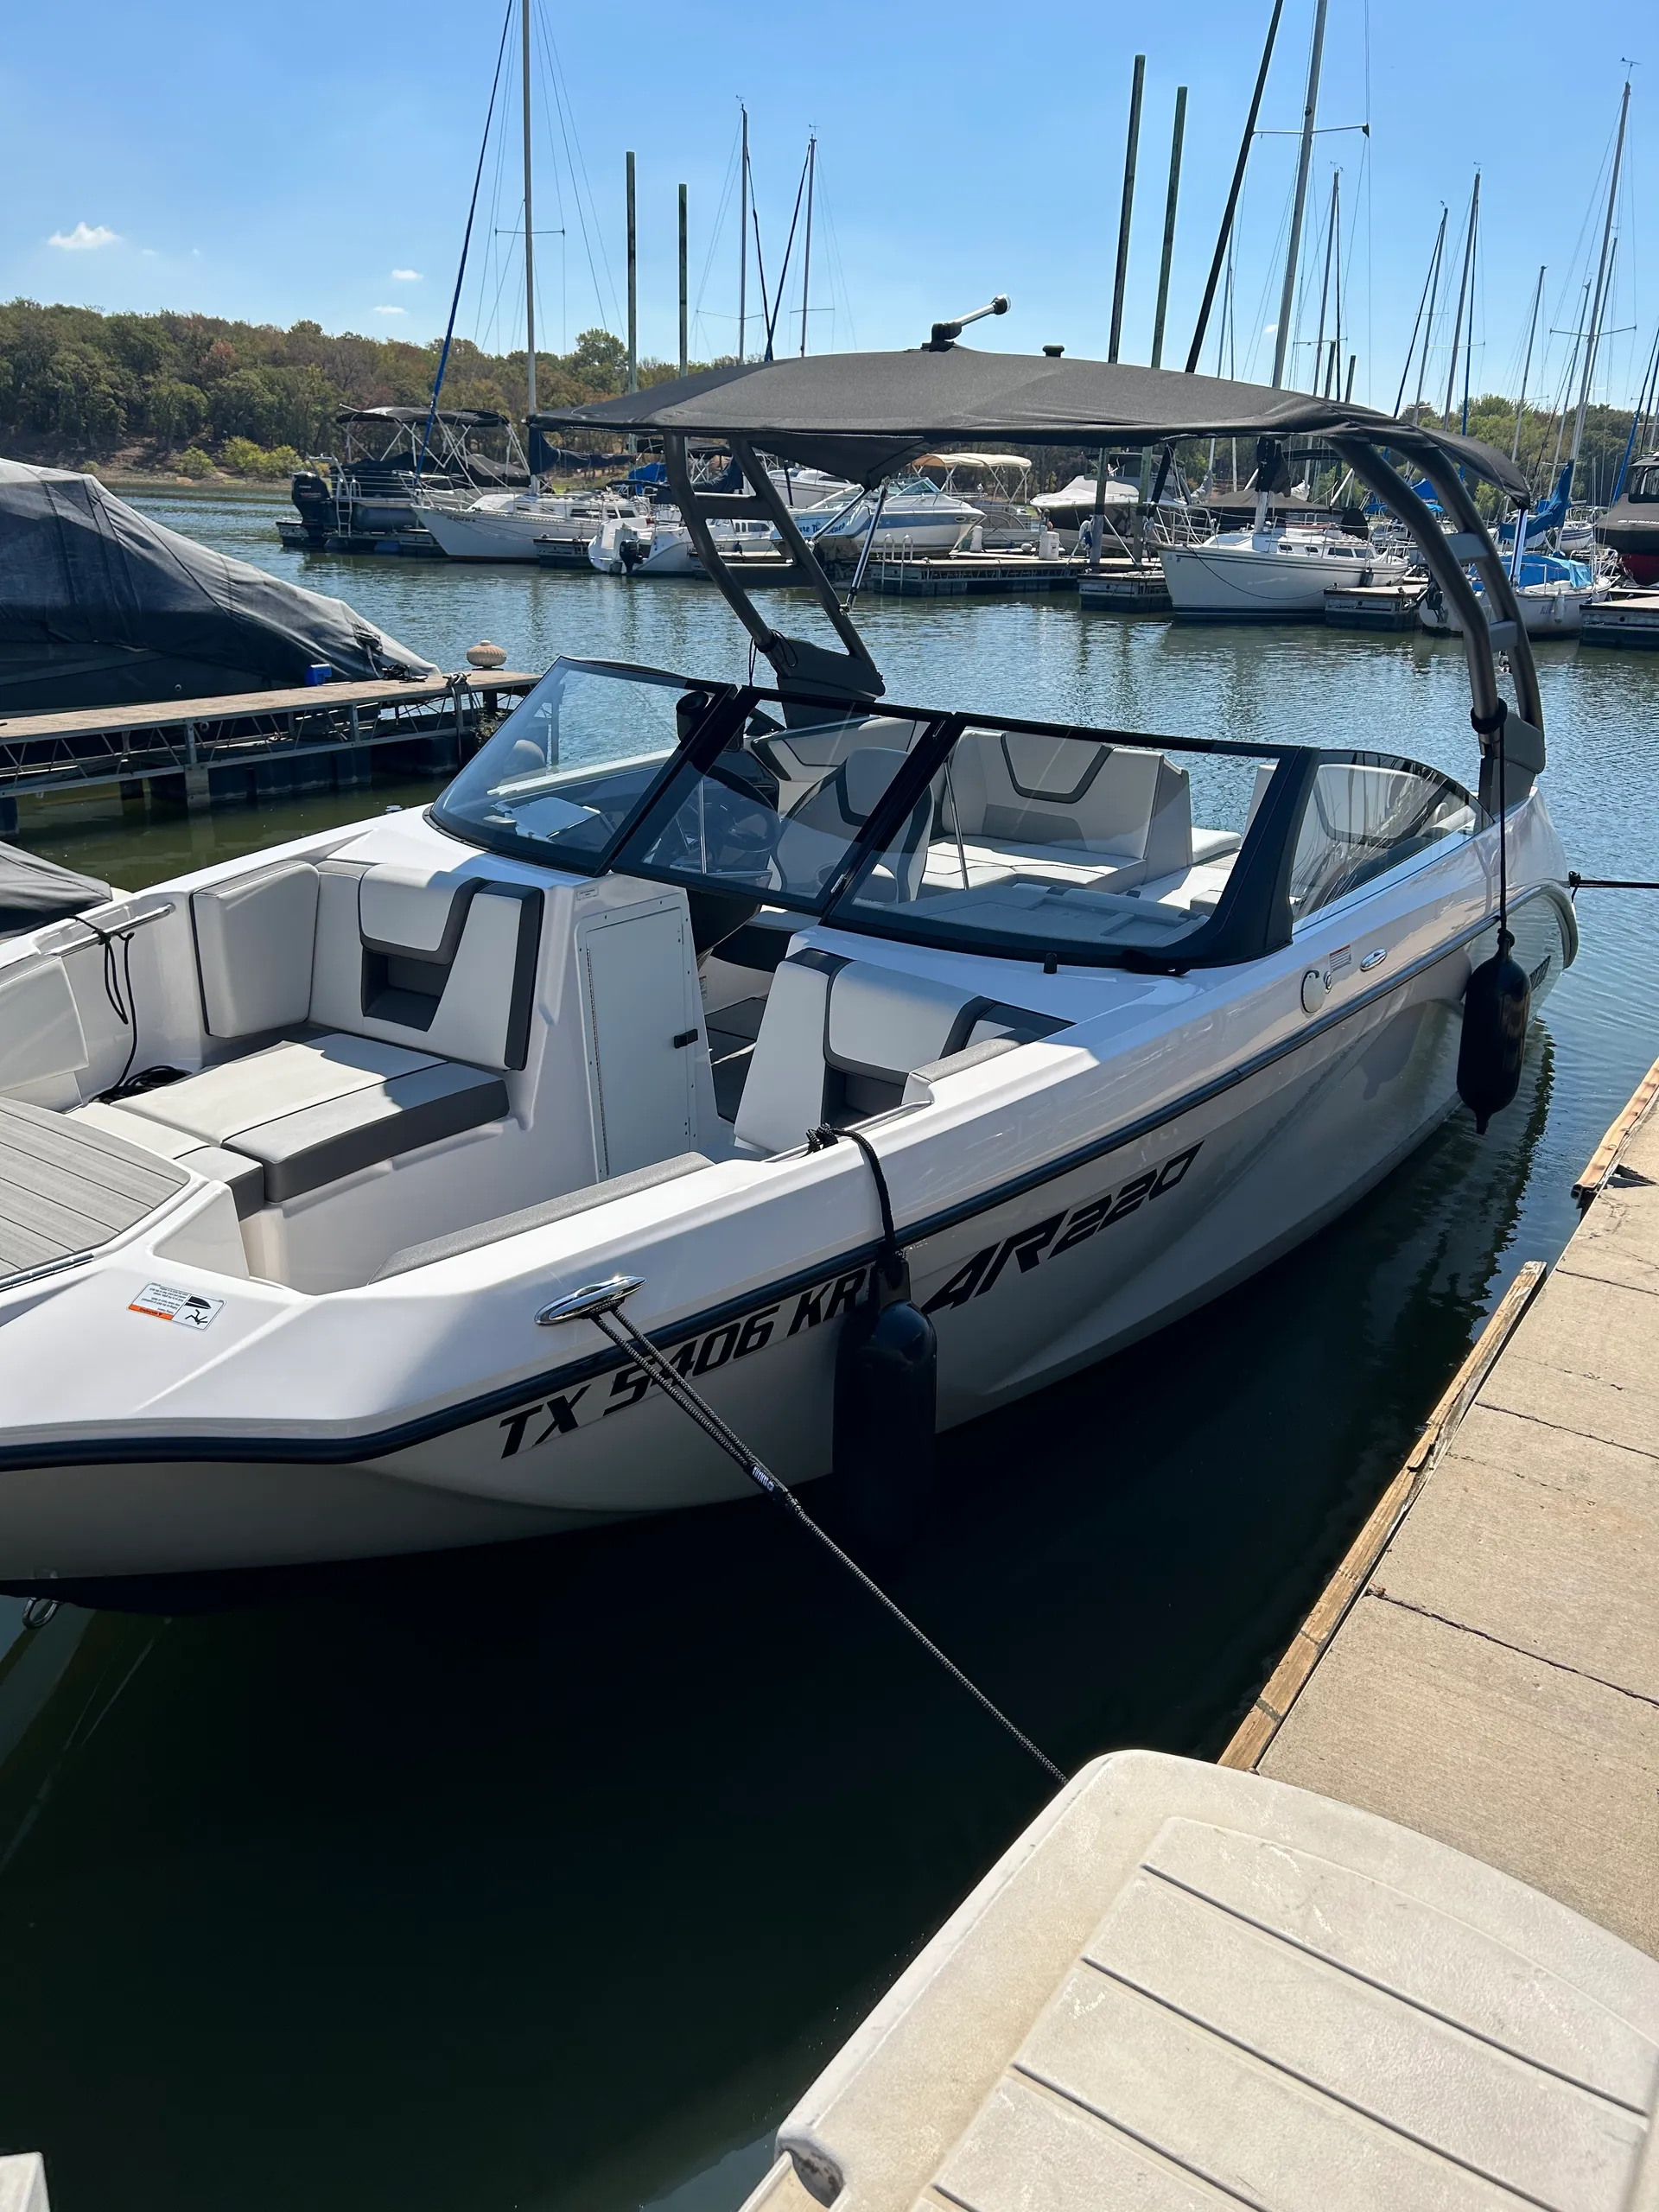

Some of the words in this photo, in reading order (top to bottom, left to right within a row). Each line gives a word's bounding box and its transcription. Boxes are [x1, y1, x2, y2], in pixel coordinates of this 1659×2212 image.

[920, 1140, 1205, 1315] AR220
[499, 1383, 592, 1459] TX
[603, 1305, 781, 1416] 5406
